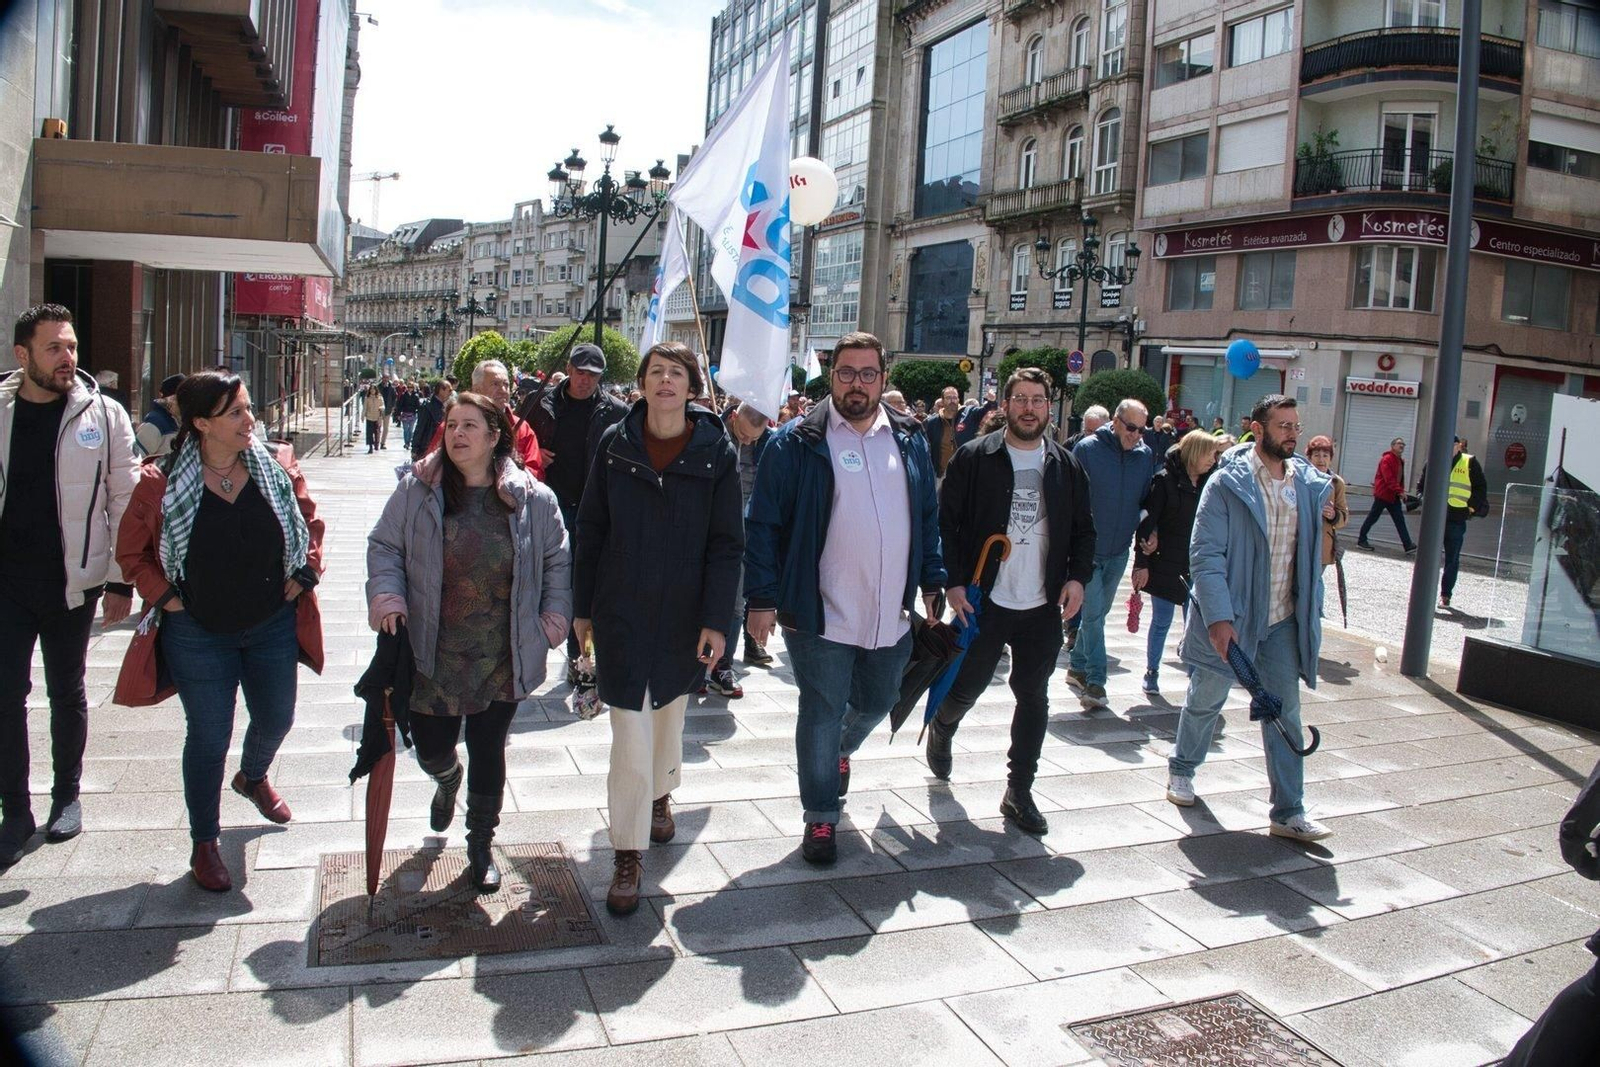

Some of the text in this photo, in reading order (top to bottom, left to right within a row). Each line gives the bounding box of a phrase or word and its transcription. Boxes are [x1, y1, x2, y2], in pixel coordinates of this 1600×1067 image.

[254, 111, 298, 122] &Collect
[1361, 212, 1446, 237] Kosmetés
[1184, 230, 1308, 248] Kosmetés Estética avanzada
[1489, 237, 1521, 252] Centro
[1523, 244, 1581, 262] especializado
[269, 283, 292, 294] contigo
[1350, 381, 1414, 395] vodafone
[80, 431, 101, 442] bng
